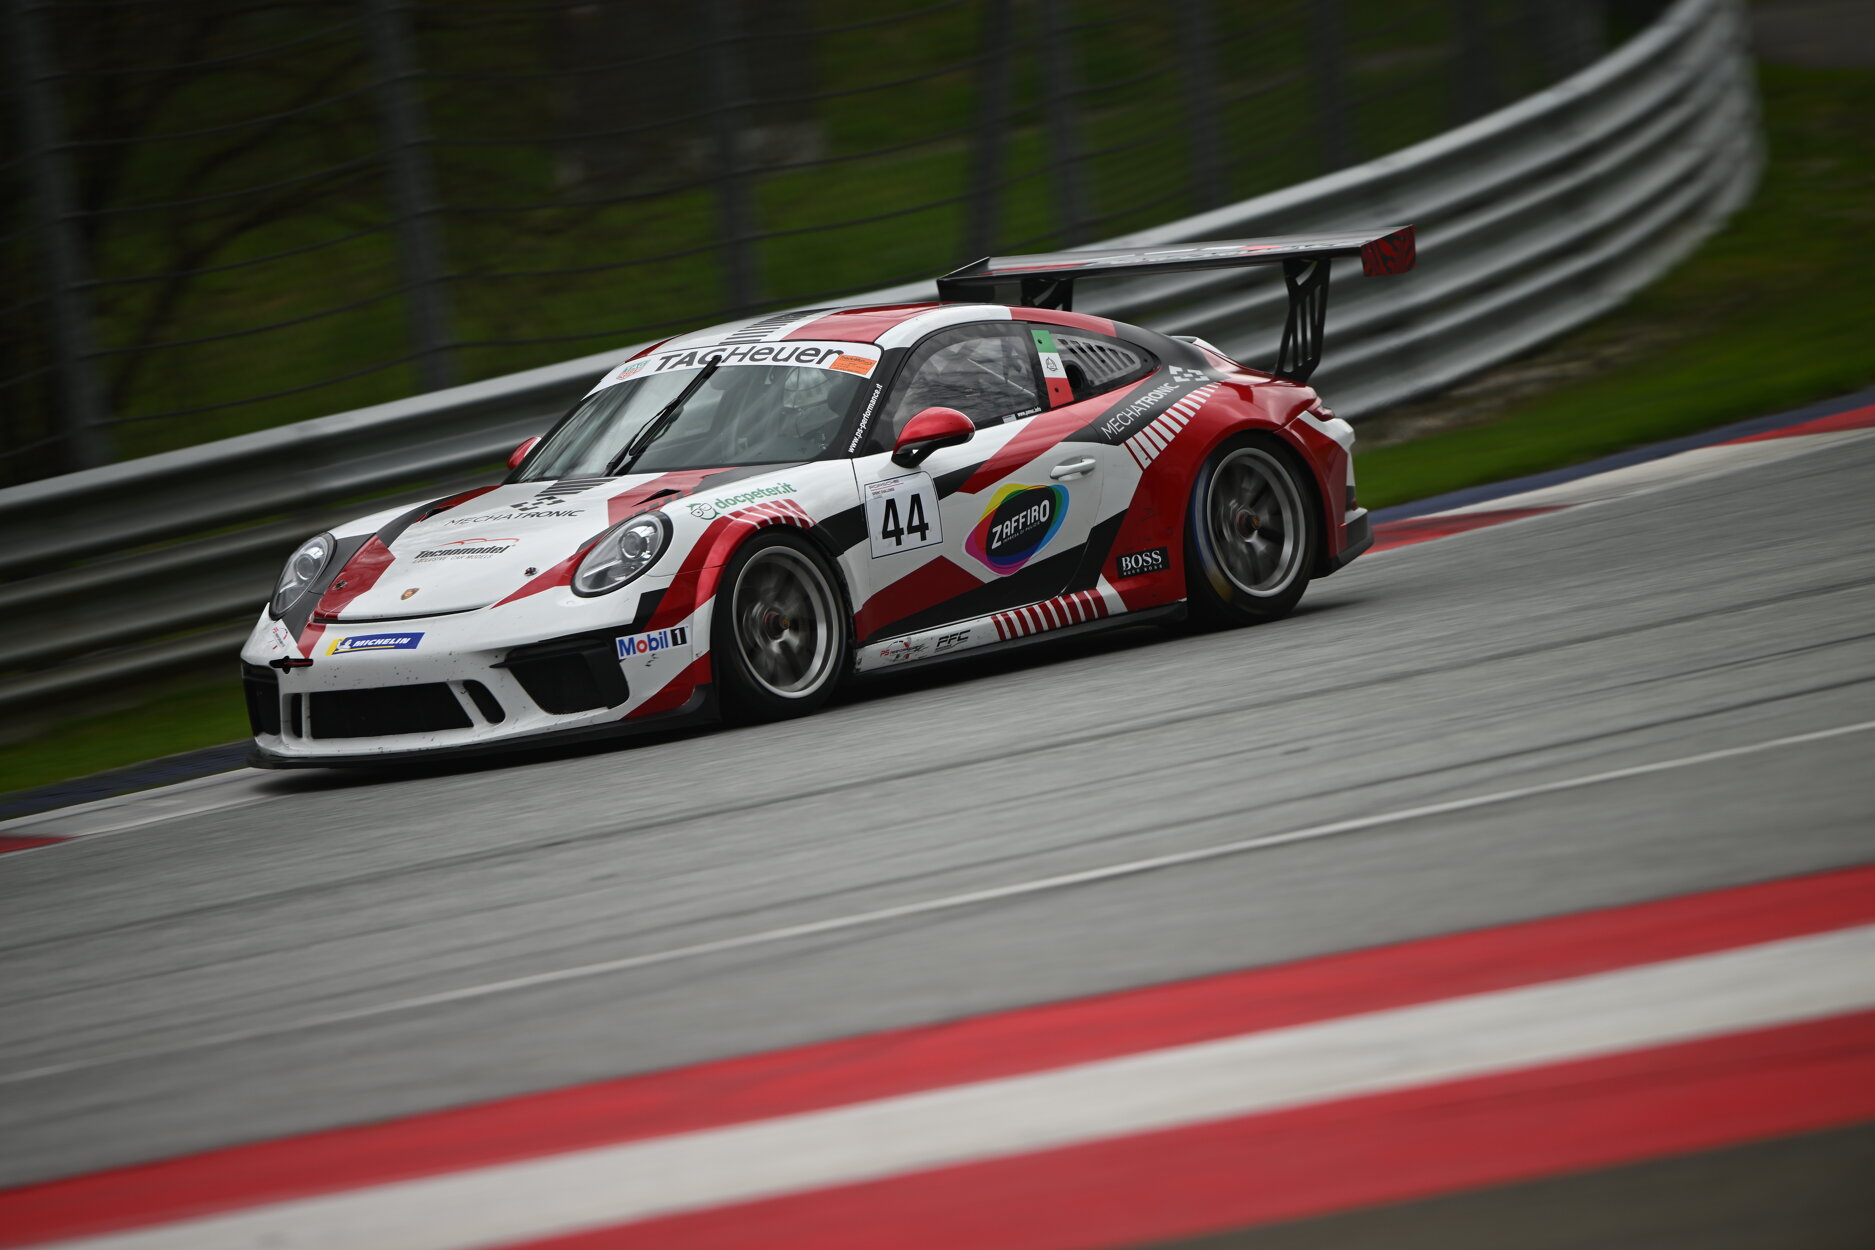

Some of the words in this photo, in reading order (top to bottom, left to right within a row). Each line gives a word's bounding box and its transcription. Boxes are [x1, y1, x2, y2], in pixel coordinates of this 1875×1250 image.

[847, 383, 883, 453] www.ps-performance.it
[1101, 382, 1180, 440] MECHATRONIC
[715, 482, 797, 509] docpeter.it
[444, 509, 585, 527] MECHATRONIC
[882, 493, 929, 546] 44
[992, 499, 1050, 549] ZAFFIRO
[414, 544, 511, 560] Tecnomodel
[1121, 550, 1162, 571] BOSS
[352, 637, 412, 648] MICHELIN
[617, 630, 669, 657] Mobil
[936, 629, 971, 648] PFC
